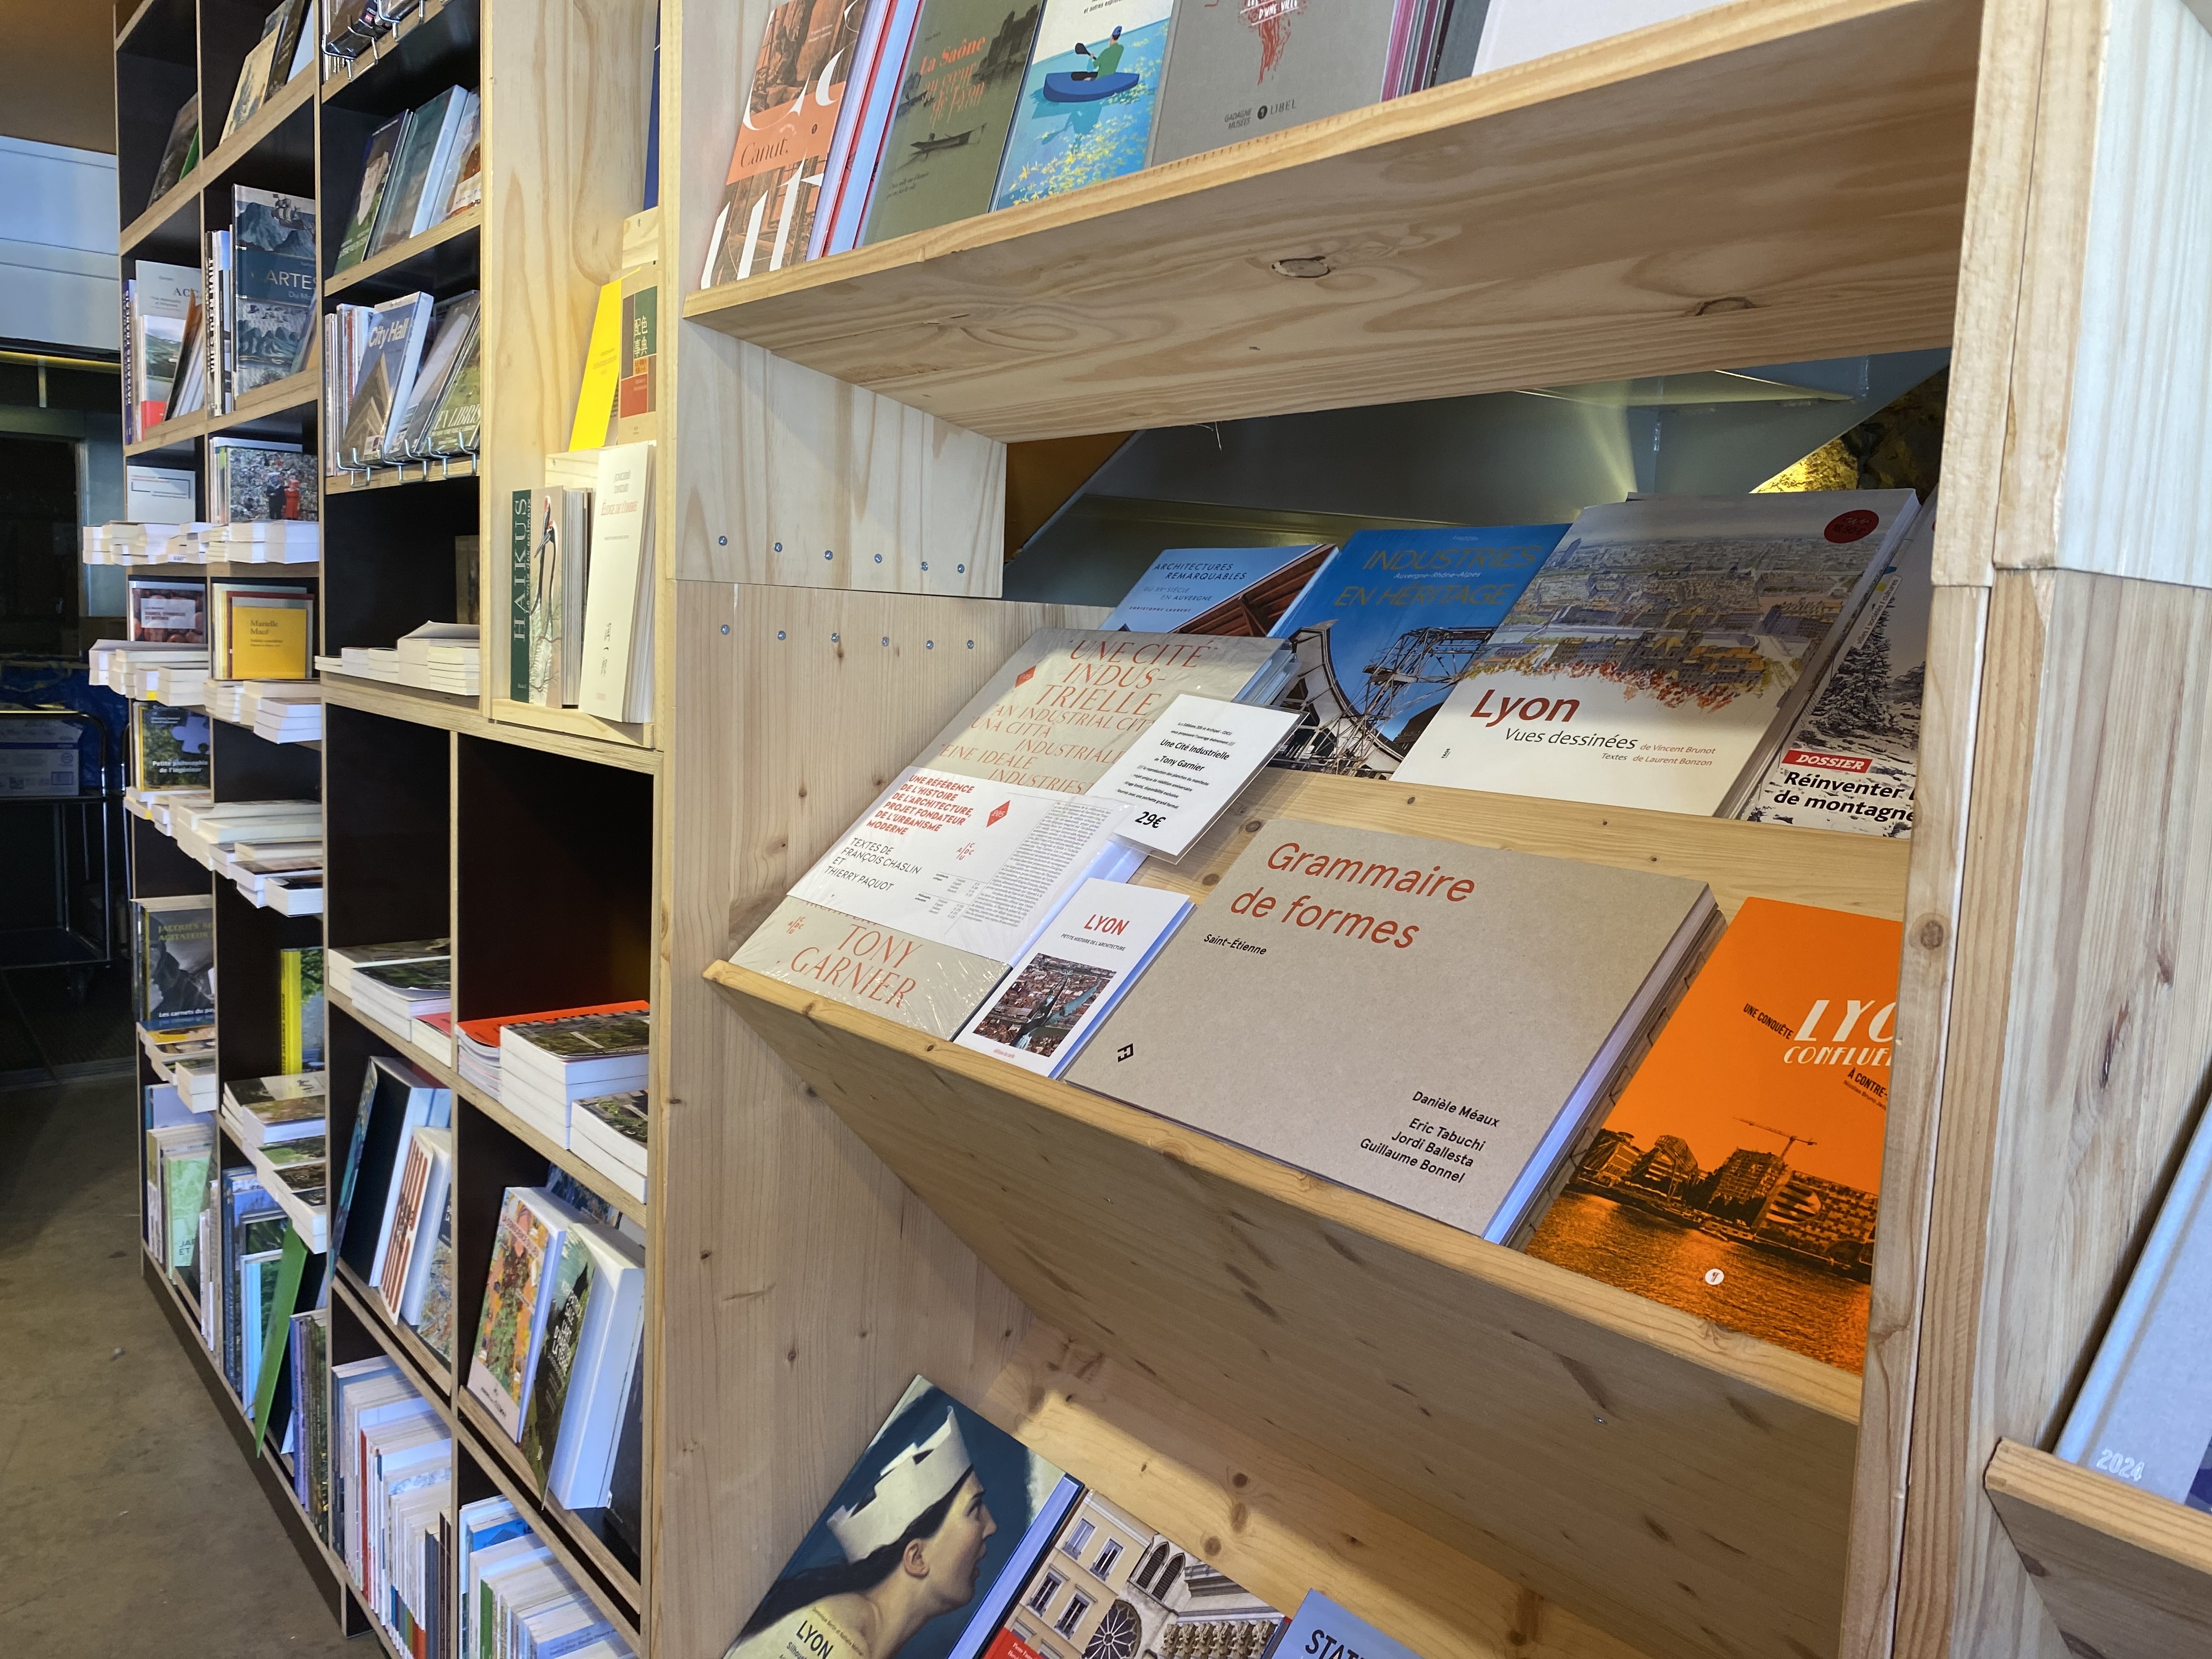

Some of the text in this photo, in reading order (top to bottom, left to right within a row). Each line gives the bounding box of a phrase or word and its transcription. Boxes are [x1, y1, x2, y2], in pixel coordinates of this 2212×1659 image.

[919, 37, 985, 75] La Saône
[1271, 99, 1296, 115] LIBEL
[369, 317, 410, 349] City Hall
[514, 498, 527, 642] HAIKUS
[1154, 563, 1234, 571] ARCHITECTURES
[1362, 545, 1543, 571] INDUSTRIES
[1165, 572, 1248, 580] REMARQUABLES
[1393, 571, 1481, 580] Auvergne-Rhône-Alpes
[1334, 582, 1515, 607] EN HÉRITAGE
[1857, 579, 1898, 646] villes sociétés cultures
[1062, 663, 1166, 690] INDUS-
[1035, 684, 1162, 716] TRIELLE
[1469, 688, 1581, 728] Lyon
[1018, 706, 1114, 729] INDUSTRIAL
[1160, 738, 1230, 760] Une Cité Industrielle
[1505, 727, 1546, 744] Vues
[1548, 730, 1639, 750] dessinées
[1653, 744, 1685, 753] Vincent
[1685, 746, 1716, 754] Brunot
[977, 750, 1037, 769] IDEALE
[1160, 755, 1178, 766] Tony
[1177, 760, 1205, 772] Garnier
[1601, 753, 1628, 761] Textes
[1645, 756, 1677, 764] Laurent
[1679, 758, 1712, 766] Bonzon
[1796, 754, 1865, 770] DOSSIER
[900, 783, 959, 802] DE L'HISTOIRE
[909, 775, 975, 794] UNE RÉFÉRENCE
[1171, 783, 1193, 792] anniversaire
[1773, 789, 1800, 805] de
[1784, 771, 1905, 799] Réinventer
[883, 801, 967, 826] PROJET FONDATEUR
[891, 792, 974, 817] DE L'ARCHITECTURE,
[866, 820, 909, 836] MODERNE
[874, 810, 943, 832] DE L'URBANISME
[1135, 811, 1166, 828] 29€
[850, 837, 894, 855] TEXTES DE
[832, 856, 845, 865] ET
[841, 847, 923, 874] FRANÇOIS CHASLIN
[1267, 842, 1476, 902] Grammaire
[824, 866, 895, 891] THIERRY PAQUOT
[1084, 915, 1130, 935] LYON
[1231, 887, 1420, 949] de formes
[837, 924, 923, 968] TONY
[1094, 941, 1126, 951] L'ARCHITECTURE
[1204, 934, 1267, 955] Saint-Étienne
[791, 947, 917, 1008] GARNIER
[1743, 1003, 1795, 1040] UNE CONQUÊTE
[1412, 1091, 1500, 1127] Danièle Méaux
[1861, 1091, 1876, 1103] Bruno
[1409, 1118, 1487, 1152] Eric Tabuchi
[1360, 1137, 1466, 1183] Guillaume Bonnel
[1391, 1131, 1475, 1167] Jordi Ballesta
[2096, 1449, 2145, 1482] 2024
[796, 1620, 833, 1659] LYON
